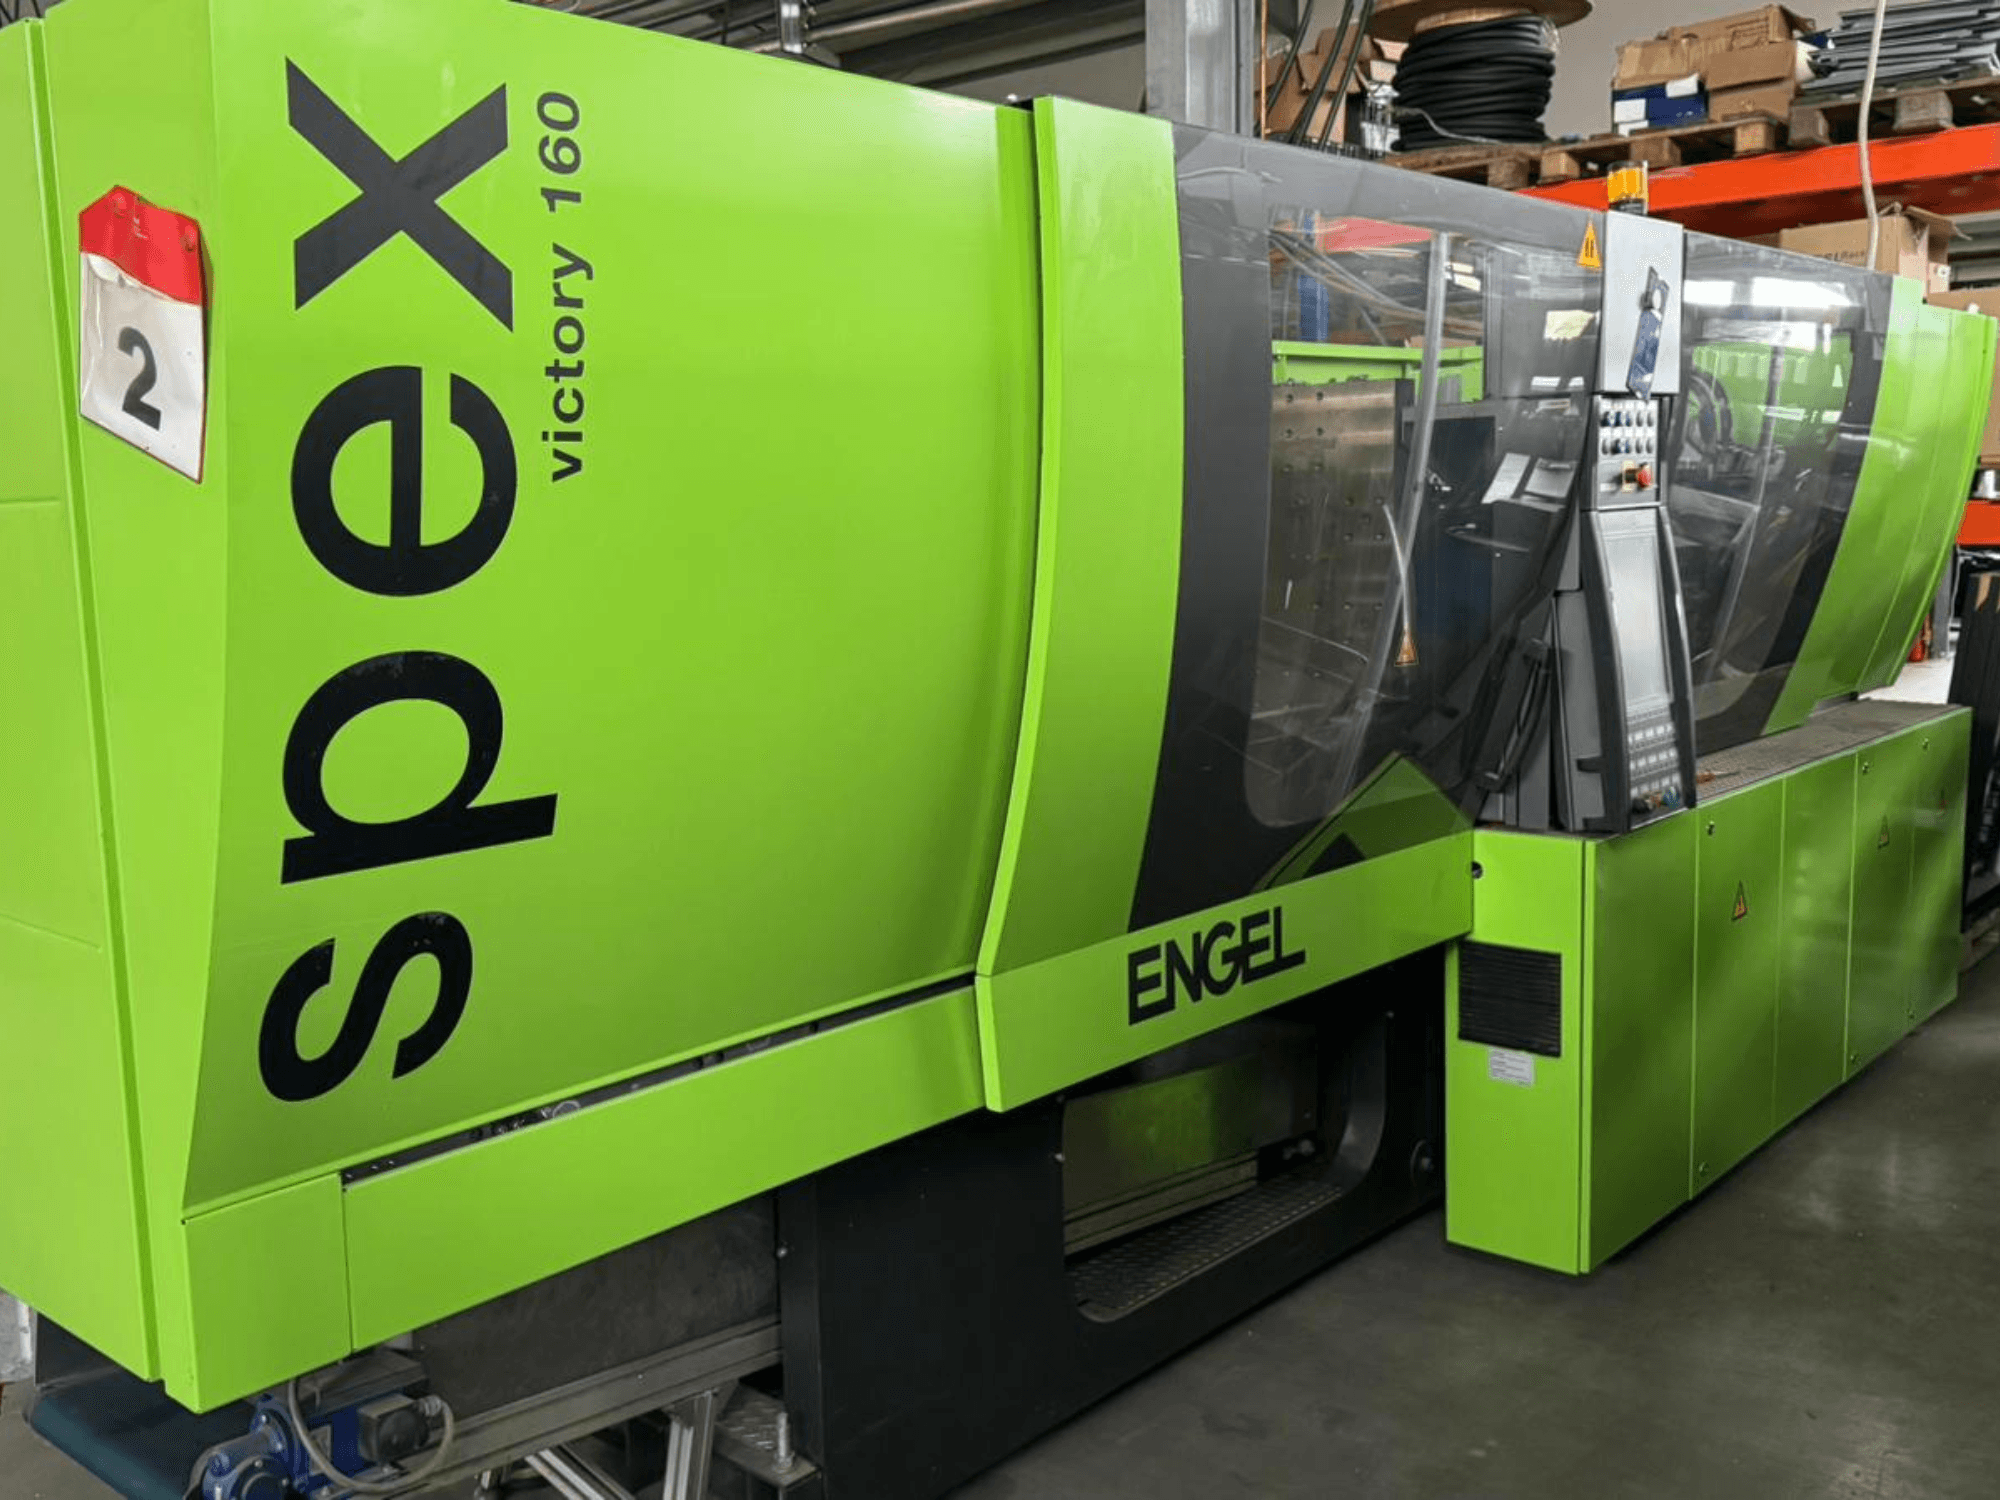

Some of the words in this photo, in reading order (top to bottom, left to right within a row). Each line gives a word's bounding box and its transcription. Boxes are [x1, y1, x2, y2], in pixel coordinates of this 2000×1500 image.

[536, 91, 582, 214] 160
[117, 326, 161, 431] 2
[541, 242, 594, 482] victory
[258, 56, 558, 1102] spex
[1127, 906, 1306, 1026] ENGEL
